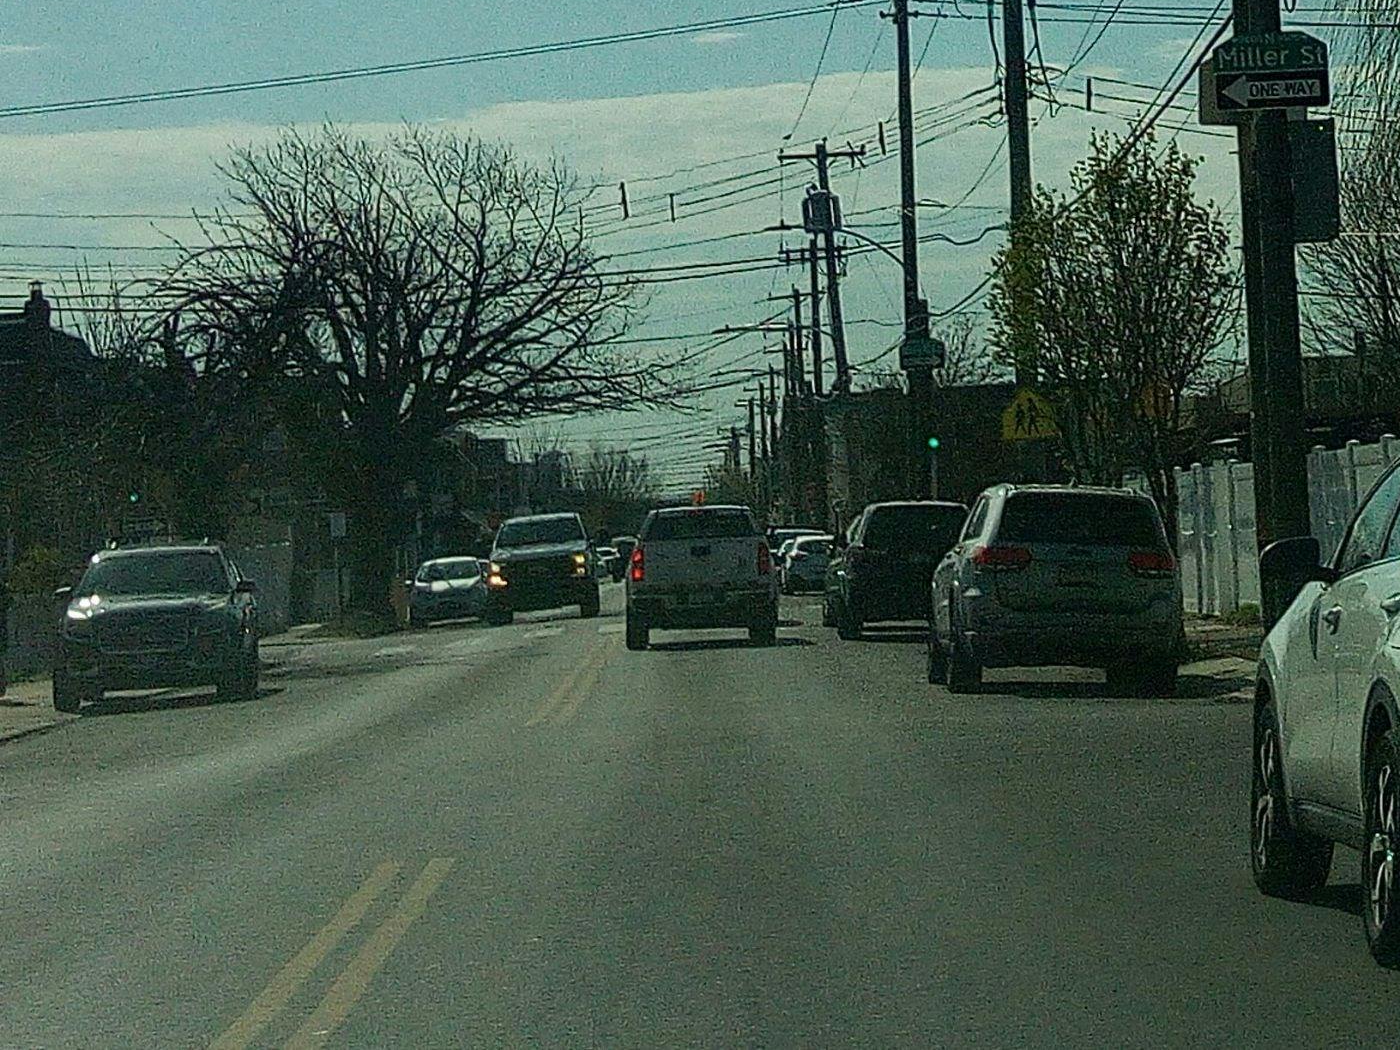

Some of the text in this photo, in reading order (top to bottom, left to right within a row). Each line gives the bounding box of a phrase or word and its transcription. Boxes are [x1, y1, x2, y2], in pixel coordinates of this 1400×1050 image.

[1218, 46, 1325, 69] Miller St
[1249, 80, 1316, 98] ONE WAY
